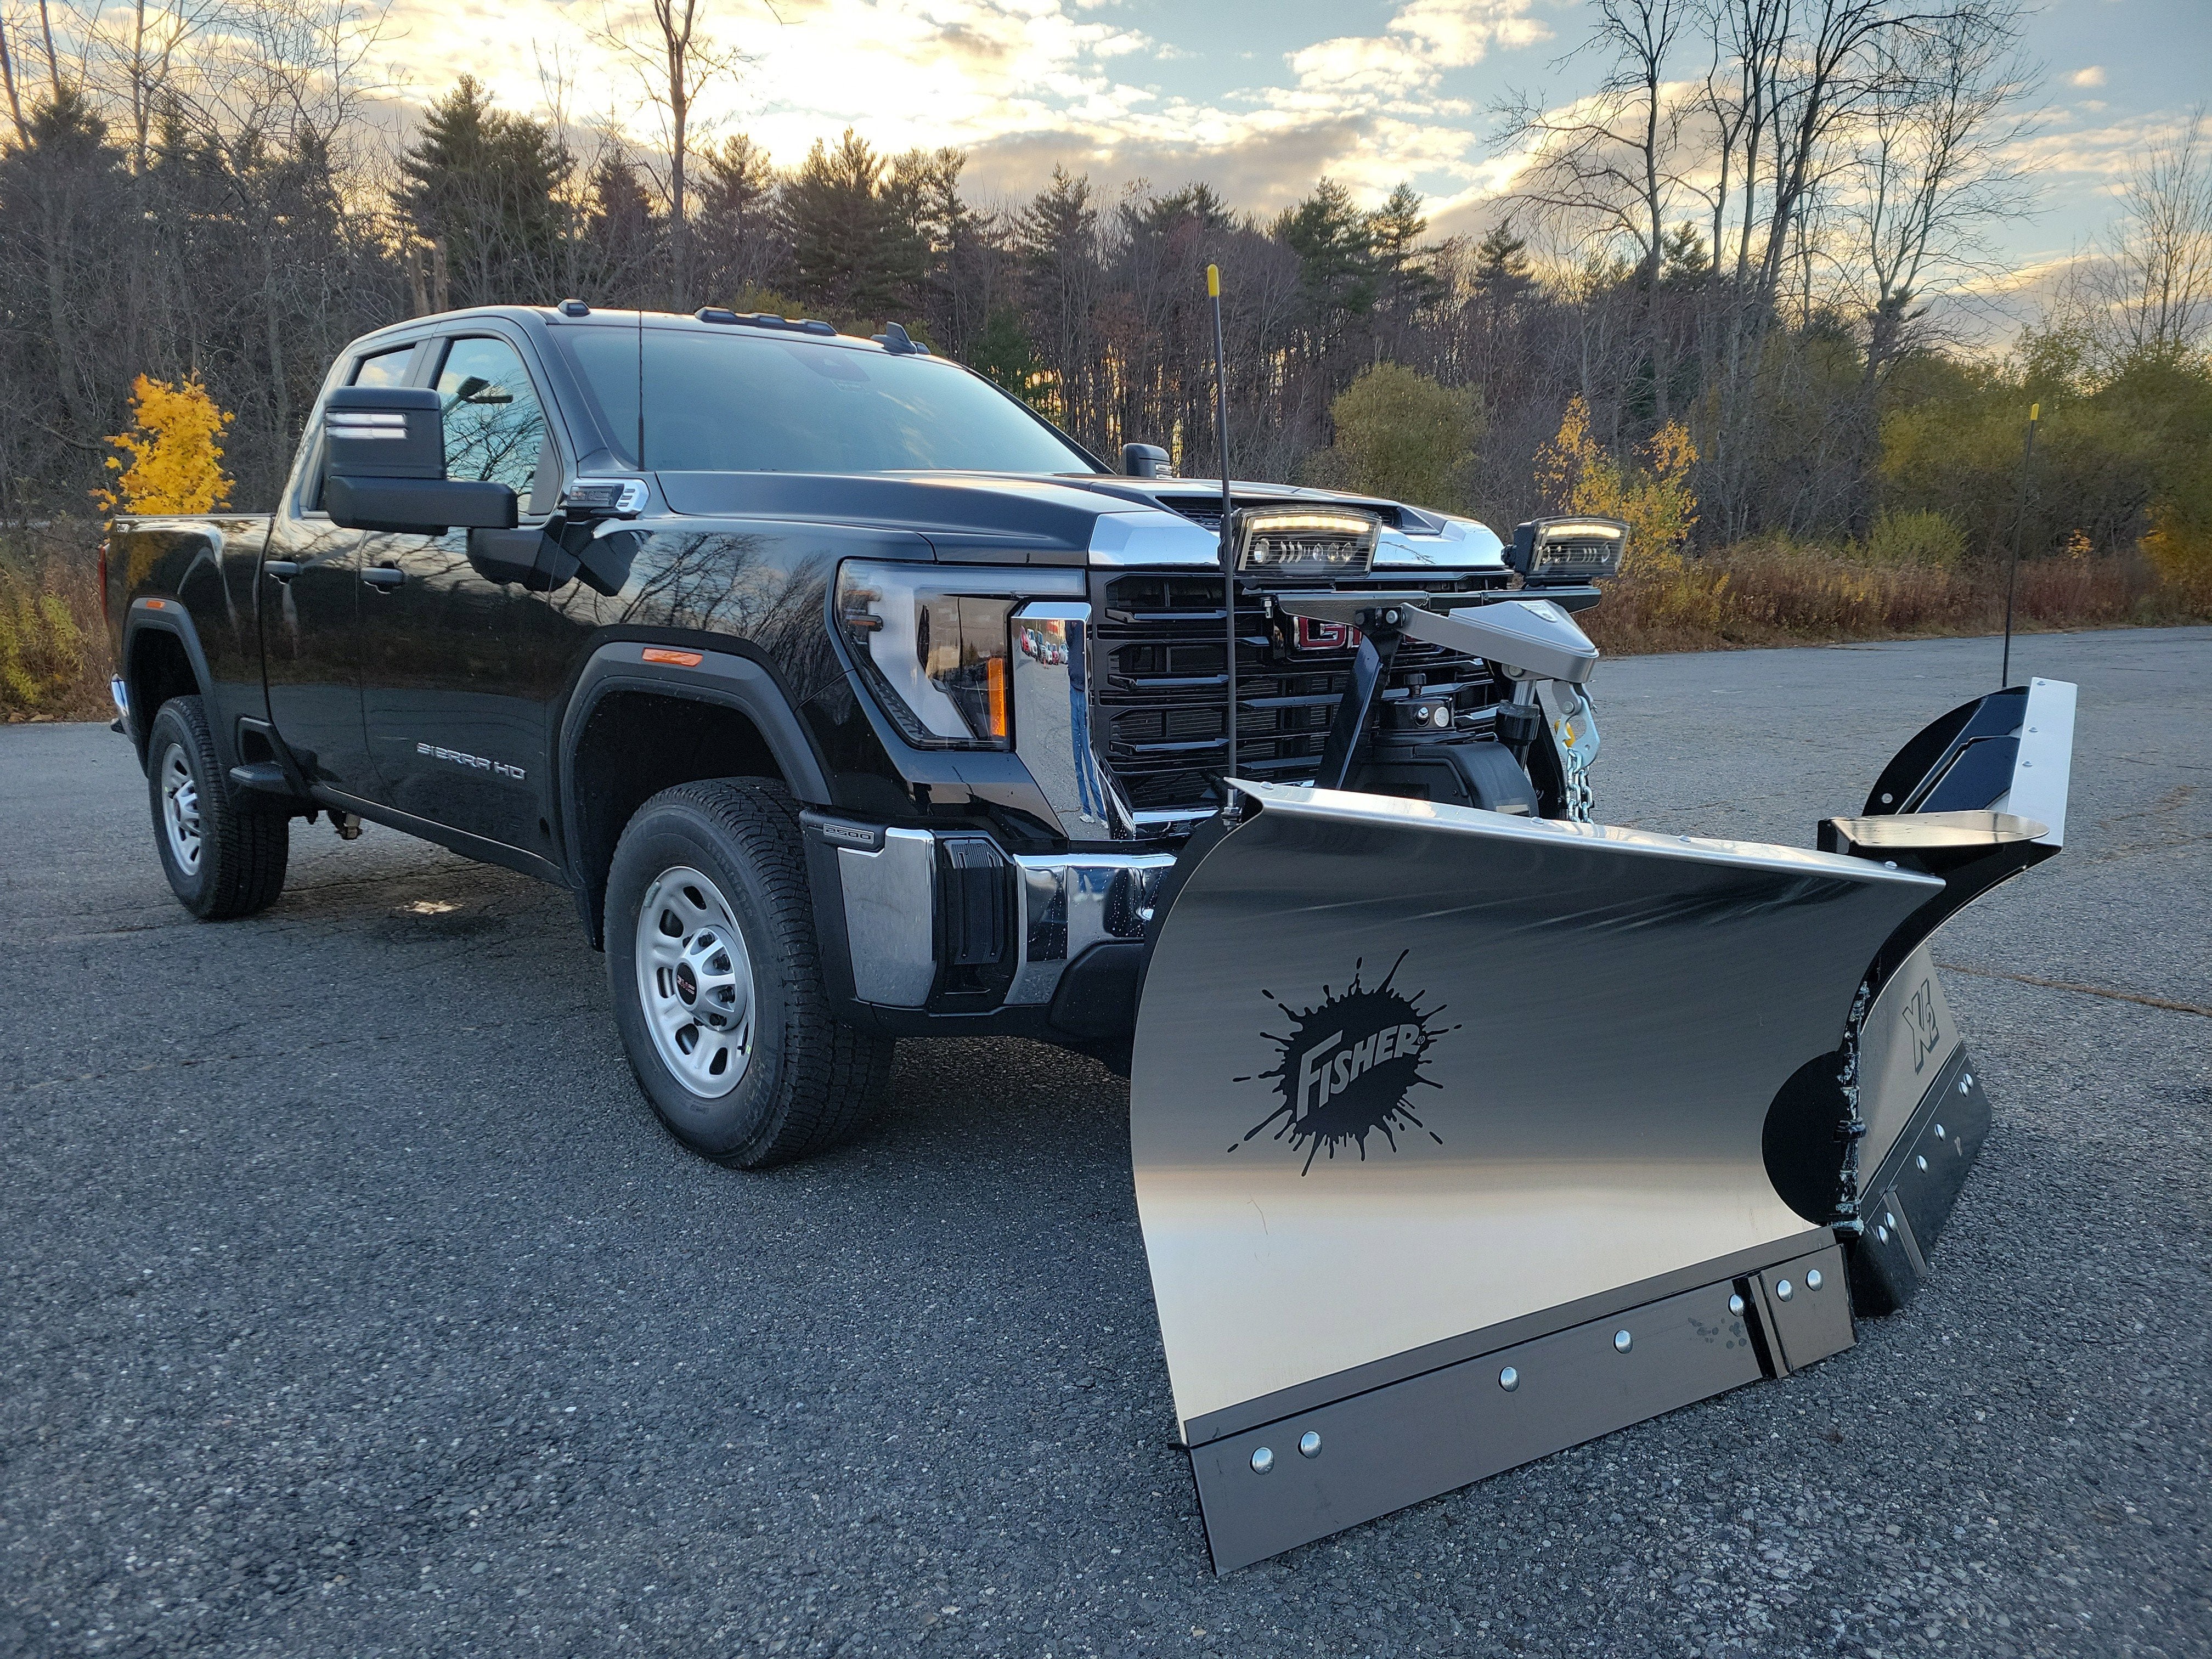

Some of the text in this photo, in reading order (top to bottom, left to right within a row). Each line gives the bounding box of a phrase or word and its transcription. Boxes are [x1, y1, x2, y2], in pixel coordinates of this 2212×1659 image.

[416, 742, 526, 780] SIERRA HD
[825, 827, 871, 840] 2500
